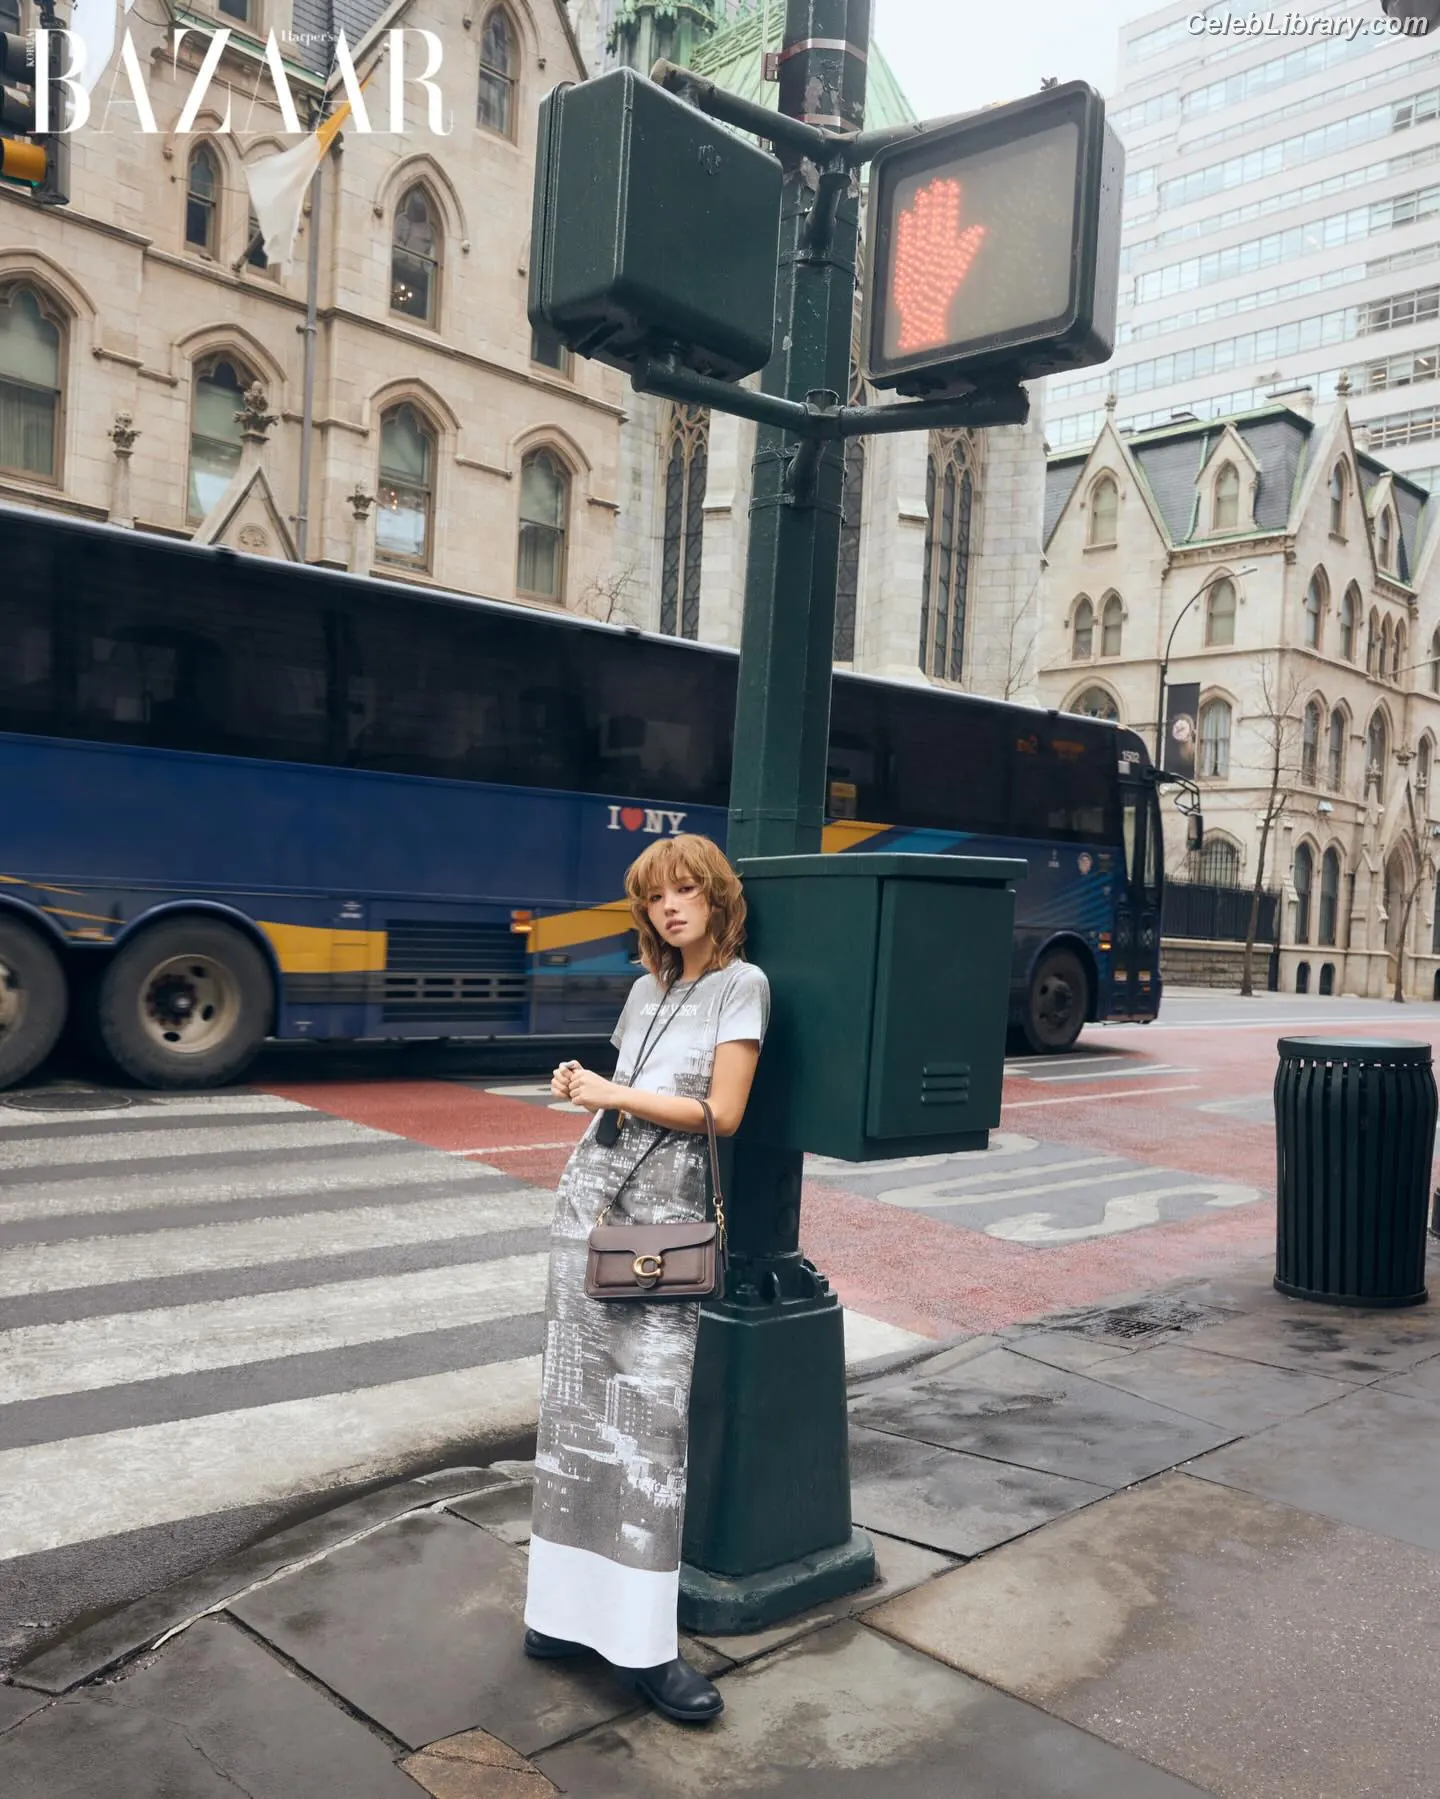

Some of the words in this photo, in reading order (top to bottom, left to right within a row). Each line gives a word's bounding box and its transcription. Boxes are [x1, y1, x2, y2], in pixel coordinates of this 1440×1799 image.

[607, 805, 621, 830] I
[642, 808, 688, 835] NY
[640, 1002, 670, 1017] NEW
